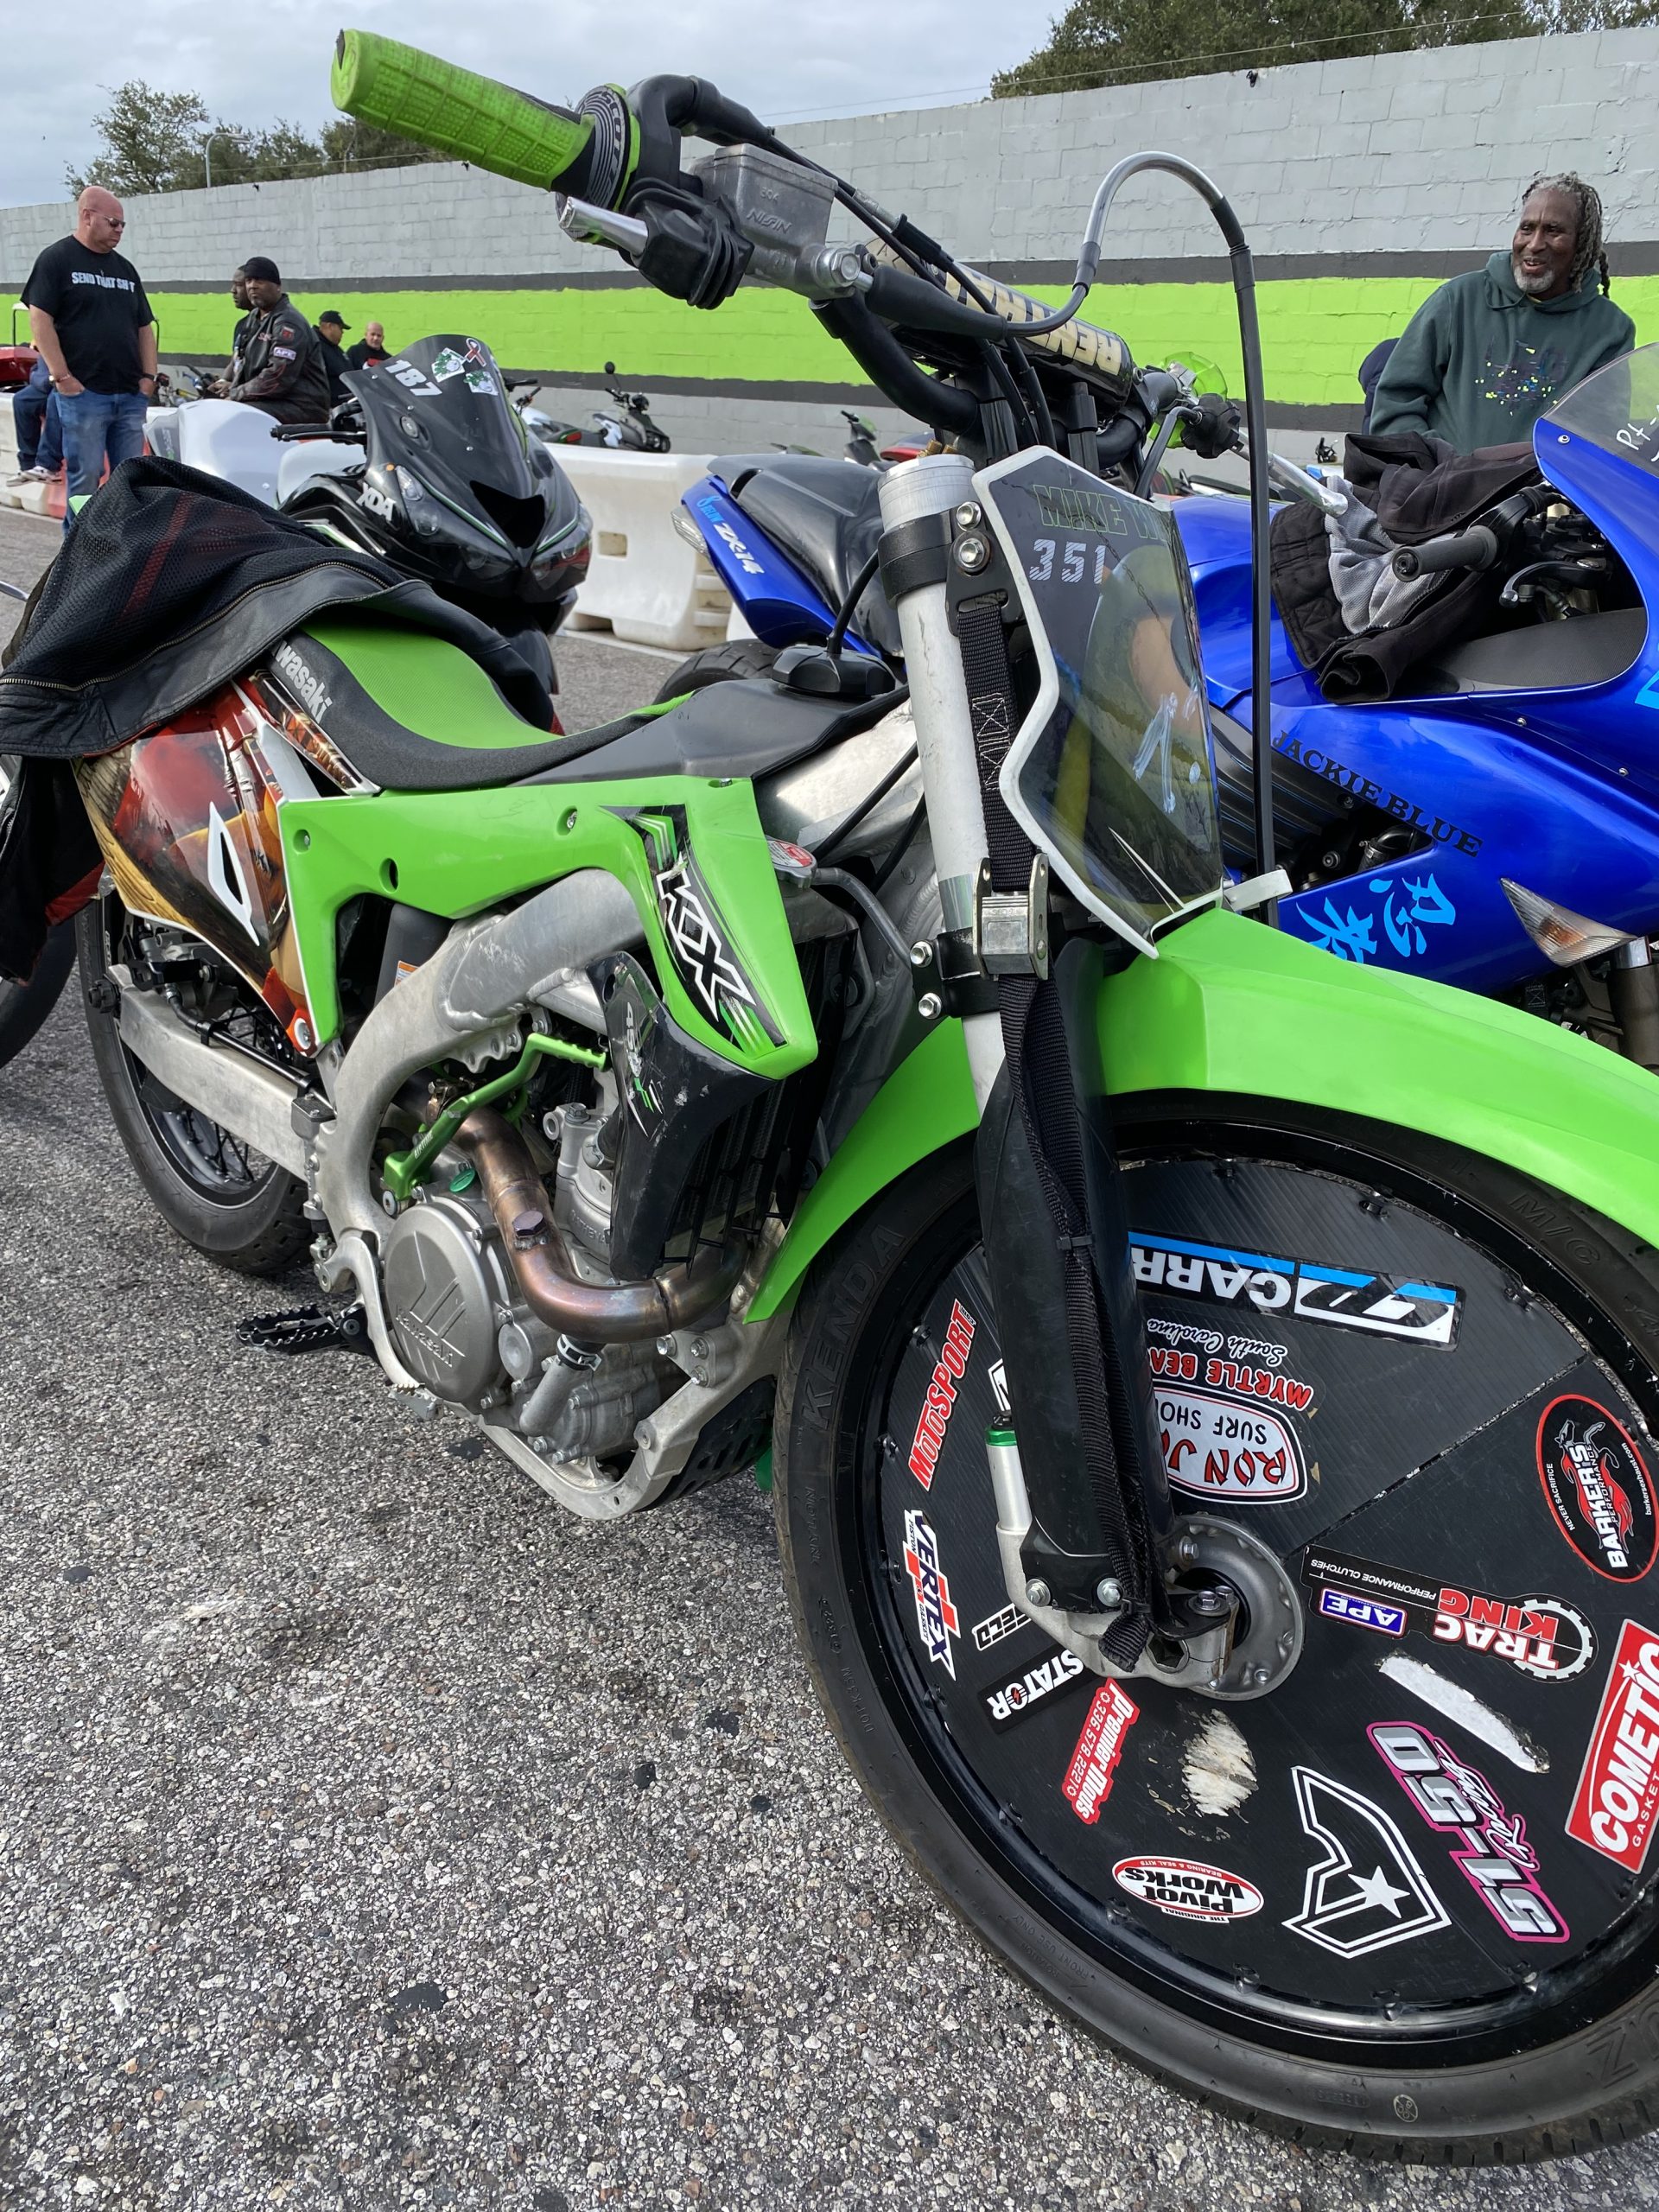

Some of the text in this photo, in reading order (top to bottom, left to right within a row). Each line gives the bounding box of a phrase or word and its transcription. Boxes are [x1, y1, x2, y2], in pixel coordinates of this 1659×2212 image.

[71, 271, 95, 285] SEND
[96, 273, 115, 289] THAT
[385, 359, 443, 397] 187
[355, 481, 397, 522] XDA
[1033, 484, 1128, 536] MIKE
[714, 523, 766, 575] ZX-14
[1029, 538, 1106, 586] 351
[276, 640, 333, 724] wasaki
[1271, 729, 1484, 858] JACKIE BLUE
[801, 1224, 907, 1431] KENDA
[1147, 1319, 1288, 1367] South Carolina
[1207, 1359, 1314, 1412] MYRTLE
[1155, 1398, 1268, 1445] SURF SHO
[1204, 1446, 1287, 1487] RON
[1585, 1443, 1619, 1523] PERFORMANCE
[1621, 1442, 1652, 1516] barkersexhaust.com
[1546, 1463, 1575, 1531] NEVER SACRIFICE
[1568, 1444, 1629, 1568] BARKER'S
[908, 1520, 918, 1553] PISTON
[914, 1514, 951, 1669] VERTEX
[1311, 1559, 1437, 1600] PERFORMANCE CLUTCHES
[1327, 1594, 1399, 1628] APE
[1437, 1588, 1560, 1643] KING
[1433, 1612, 1560, 1671] TRAC
[986, 1649, 1084, 1720] STATOR
[1069, 1700, 1107, 1789] 336.578.2221
[1372, 1726, 1557, 1934] 51-50
[1433, 1739, 1537, 1870] Racing
[1124, 1866, 1245, 1900] Works
[1187, 1864, 1224, 1878] BEARING
[1142, 1885, 1234, 1914] Pivot
[1165, 1908, 1207, 1921] ORIGINAL
[1013, 1913, 1089, 1979] FRONT USE ONLY
